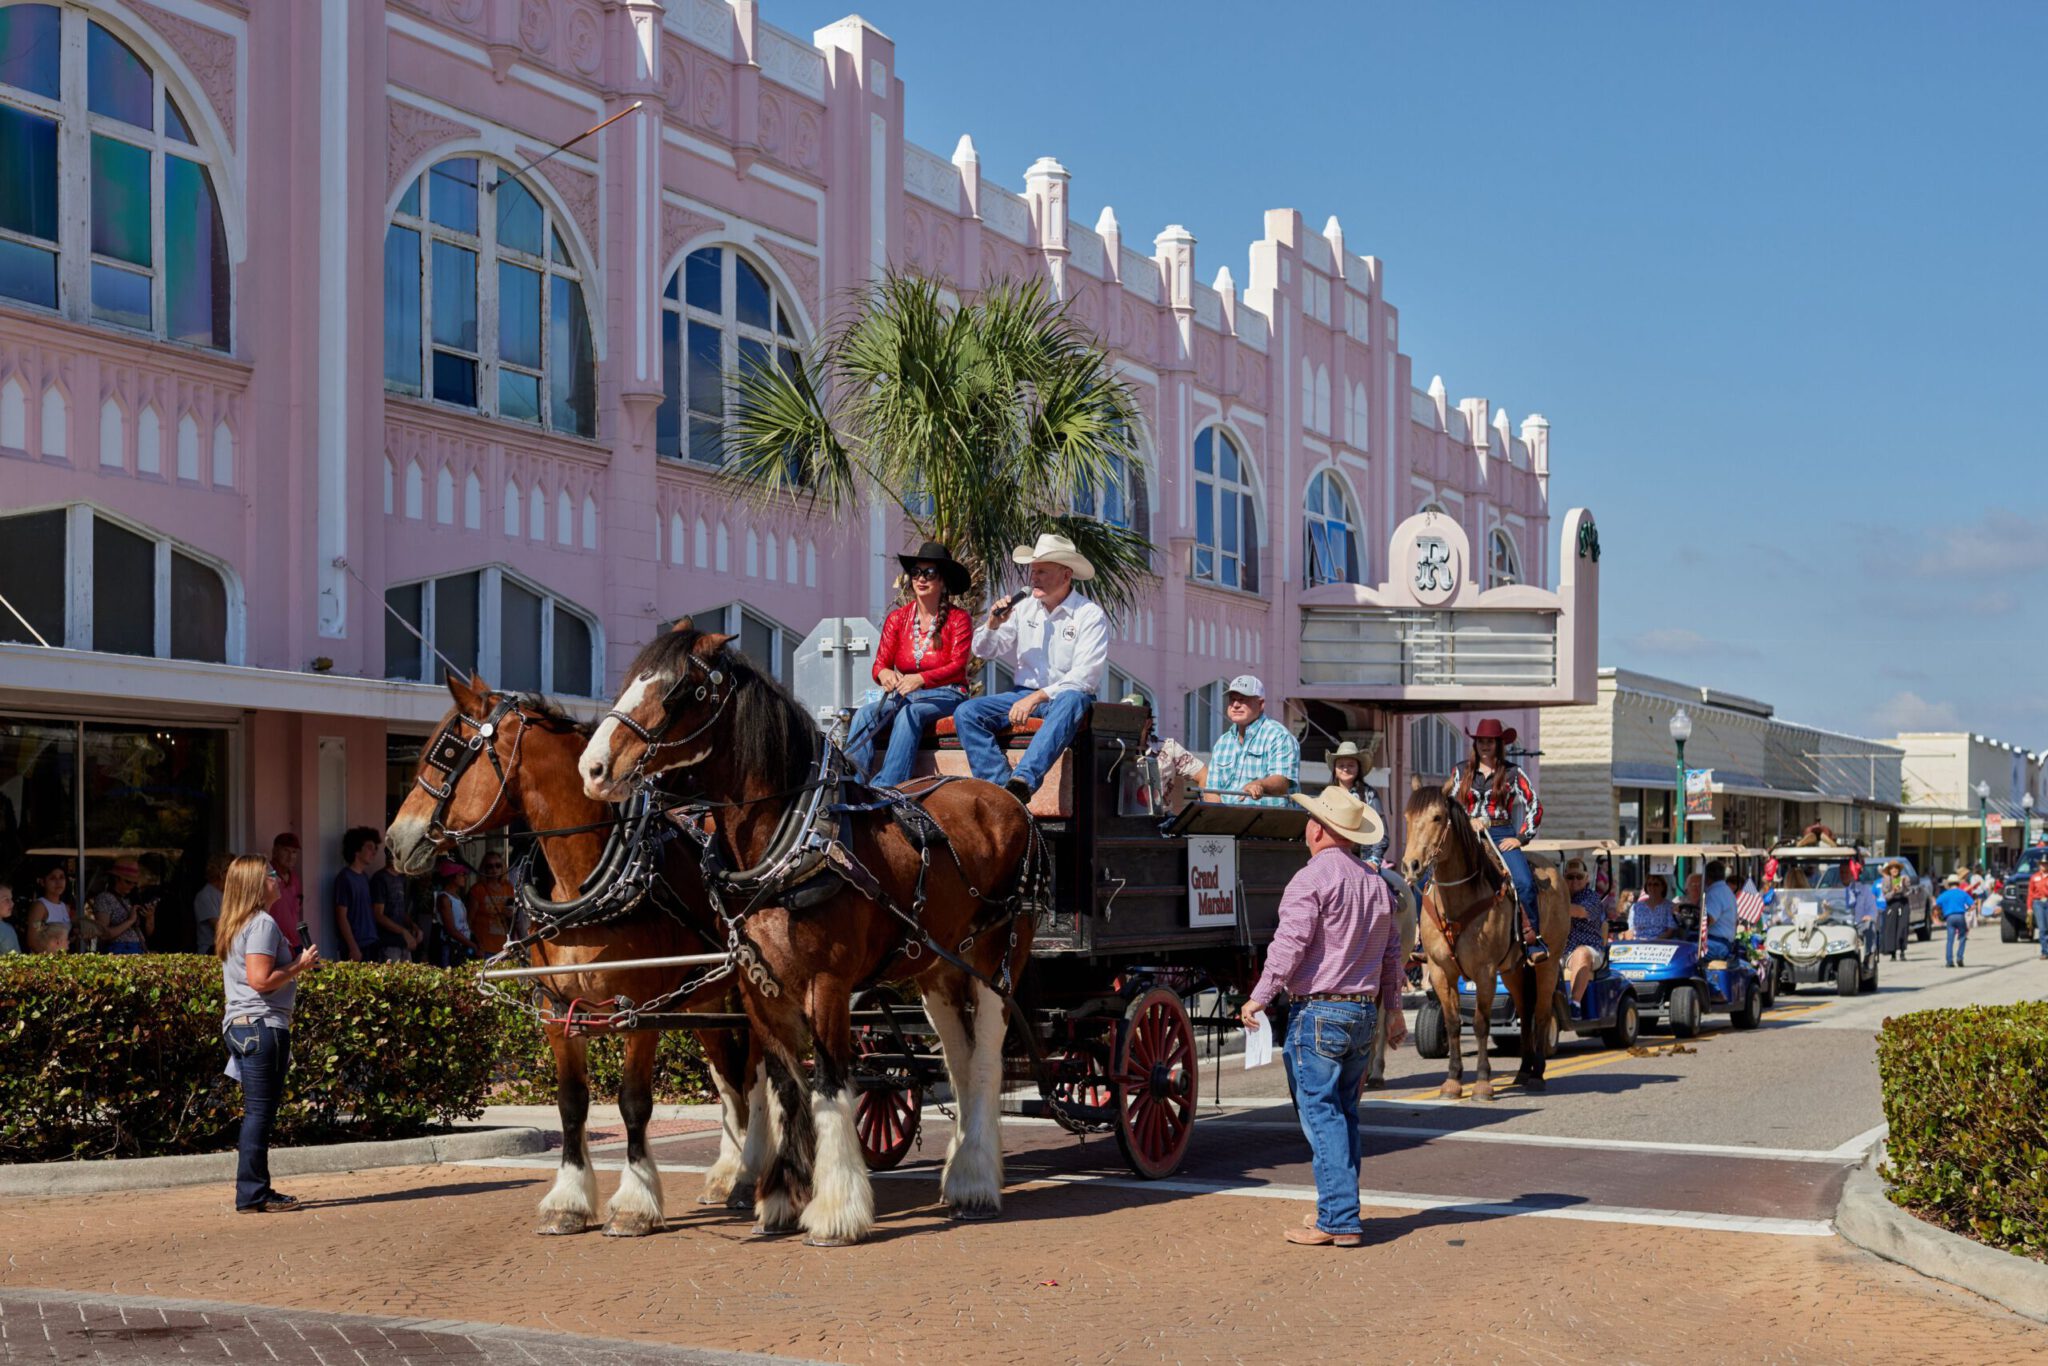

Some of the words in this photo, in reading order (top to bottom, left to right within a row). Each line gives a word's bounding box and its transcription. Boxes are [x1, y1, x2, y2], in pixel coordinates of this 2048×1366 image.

[1191, 864, 1219, 890] Grand
[1656, 863, 1668, 872] 12
[1198, 890, 1234, 915] Marshal
